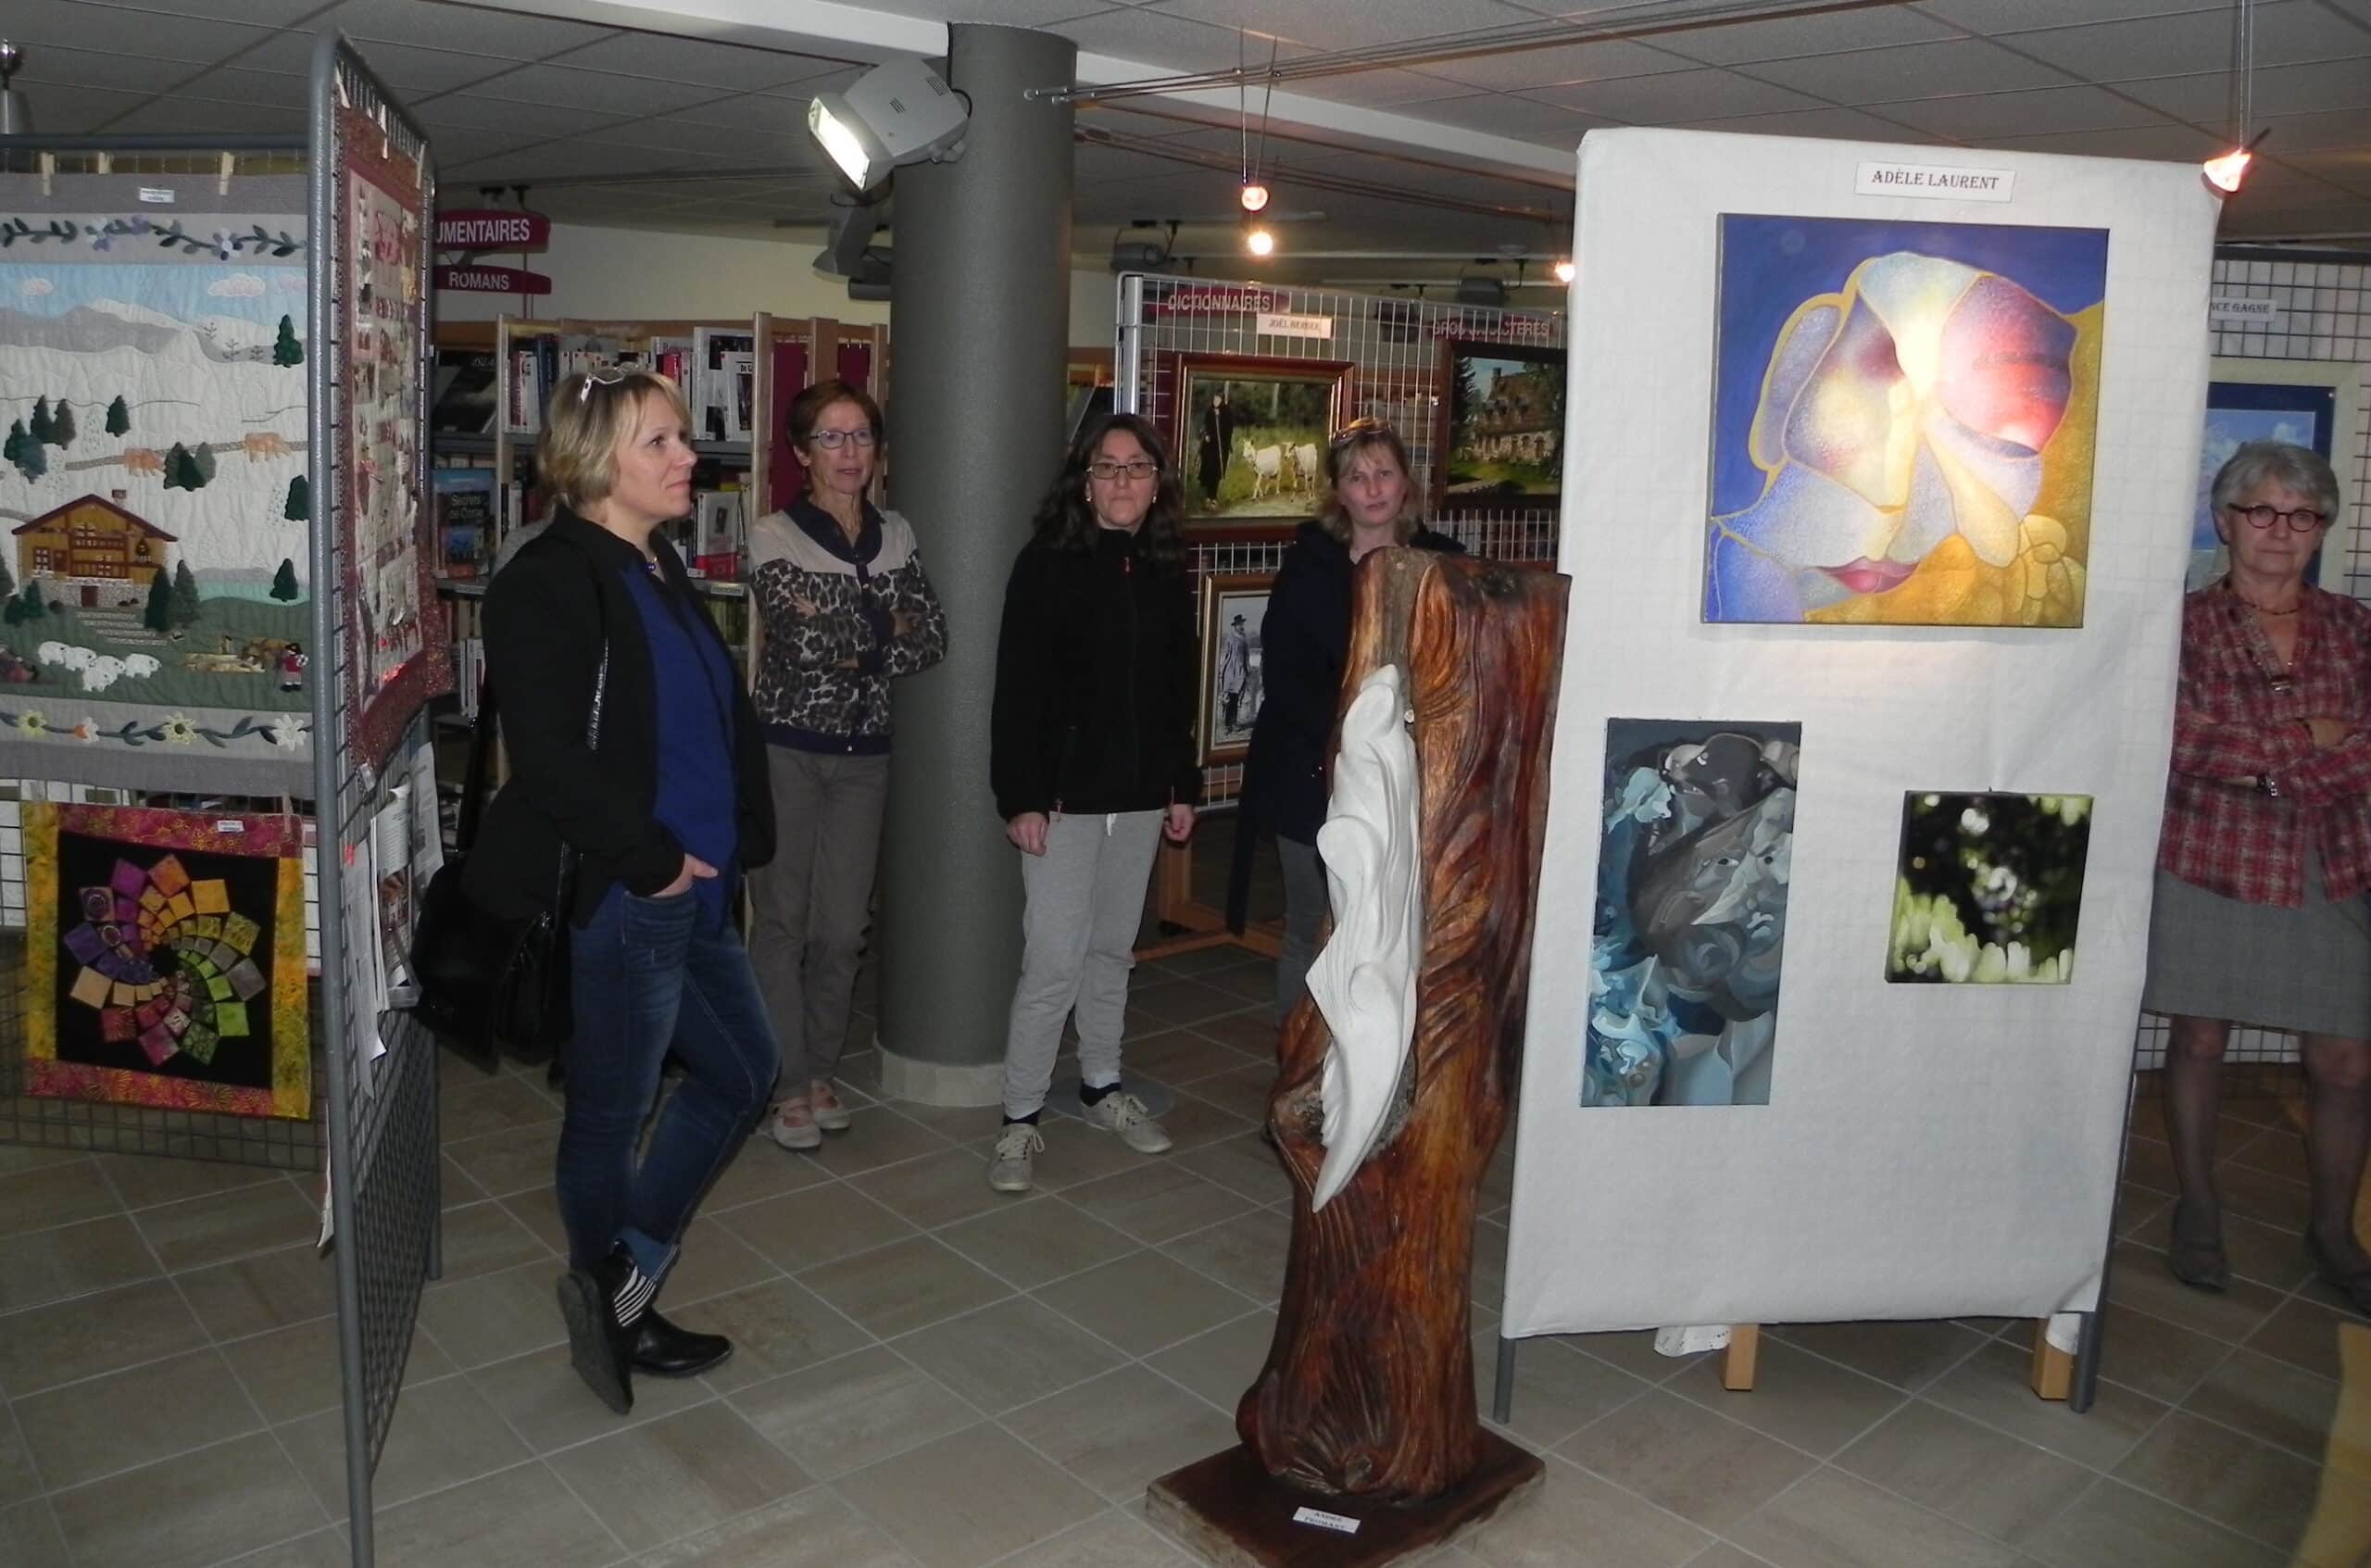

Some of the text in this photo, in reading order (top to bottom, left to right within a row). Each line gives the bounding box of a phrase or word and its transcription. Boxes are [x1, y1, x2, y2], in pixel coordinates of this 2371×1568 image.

[1872, 169, 2000, 191] ADÈLE LAURENT
[448, 271, 509, 291] ROMANS
[1167, 295, 1271, 313] DICTIONNAIRES
